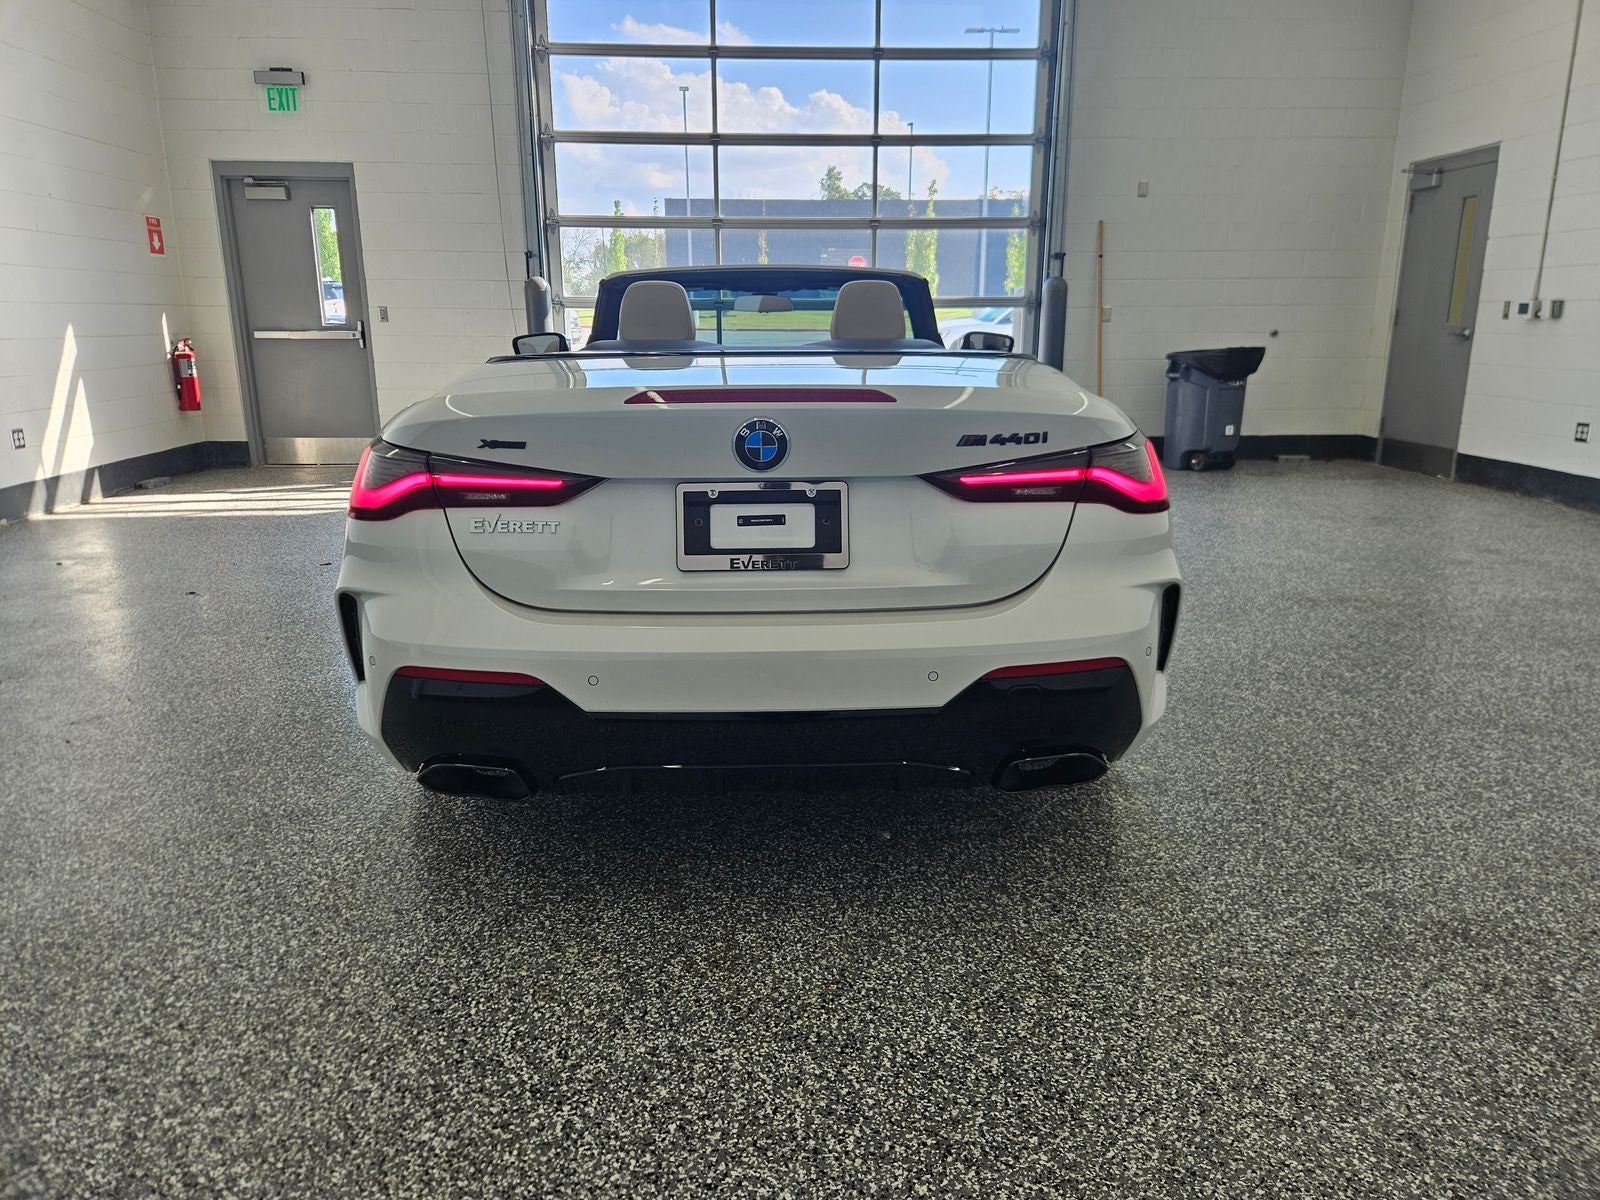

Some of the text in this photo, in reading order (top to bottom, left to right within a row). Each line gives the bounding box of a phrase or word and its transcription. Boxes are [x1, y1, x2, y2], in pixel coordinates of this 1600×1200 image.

[266, 87, 298, 111] EXIT
[740, 420, 783, 437] BMW
[469, 513, 560, 534] EVERETT
[729, 554, 798, 570] EVERETT
